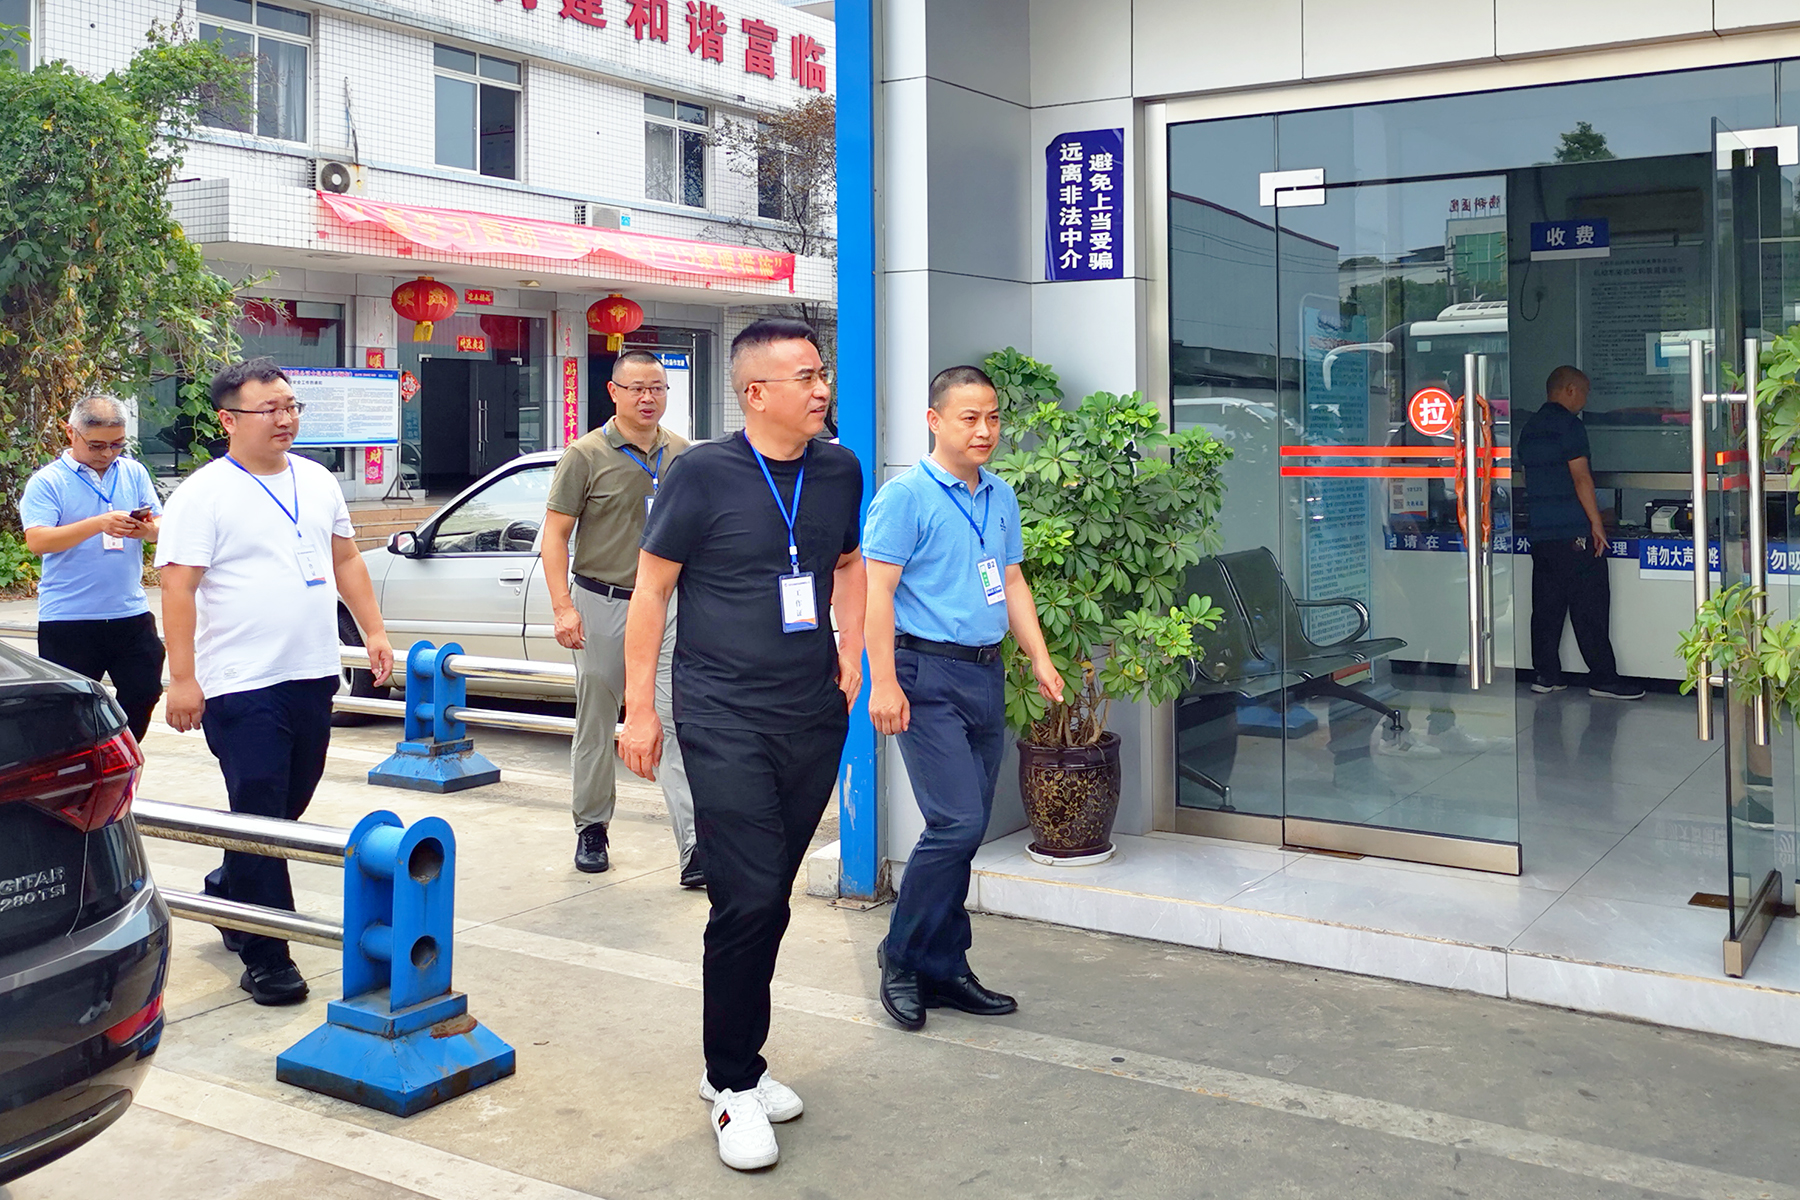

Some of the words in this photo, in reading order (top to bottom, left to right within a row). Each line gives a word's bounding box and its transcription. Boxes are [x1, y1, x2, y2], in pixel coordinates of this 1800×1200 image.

[494, 0, 827, 94] 建和谐富临
[1059, 142, 1083, 269] 远离非法中介
[1088, 152, 1114, 270] 避免上当受骗
[1546, 225, 1595, 247] 收费
[1418, 397, 1448, 426] 拉
[1646, 545, 1719, 568] 请勿大声哗
